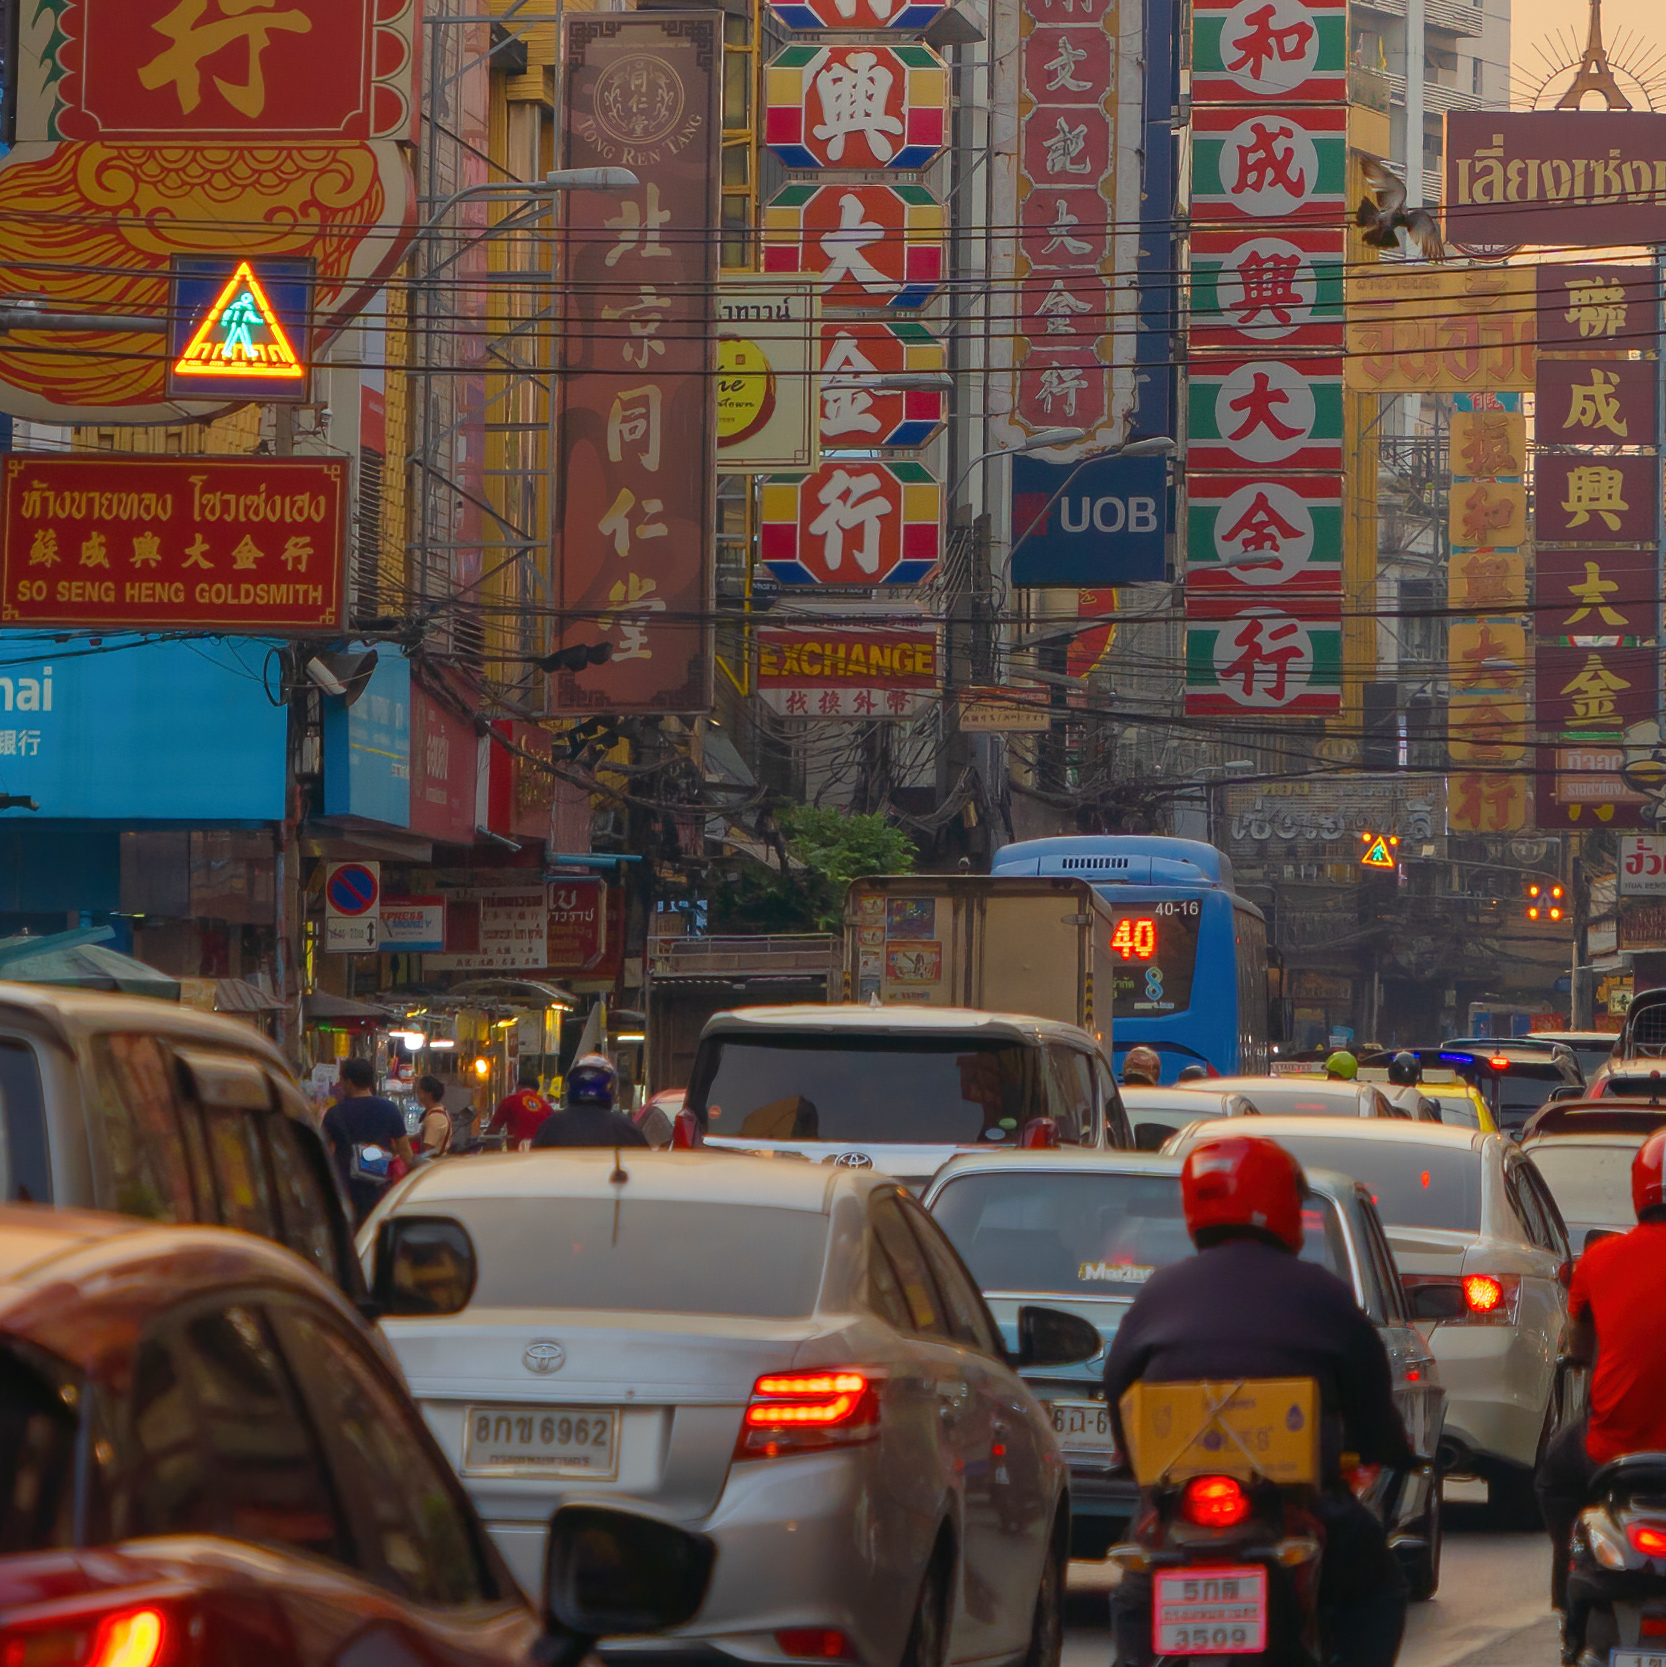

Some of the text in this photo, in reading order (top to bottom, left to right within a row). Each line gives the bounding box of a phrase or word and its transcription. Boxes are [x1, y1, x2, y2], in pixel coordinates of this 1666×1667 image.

[577, 113, 703, 166] TONG REN TANG
[21, 479, 172, 522] ห้างขายทอง
[1060, 495, 1158, 534] UOB
[1560, 276, 1632, 822] 聯成興大金
[17, 578, 324, 606] SO SENG HENG GOLDSMITH
[759, 641, 934, 677] EXCHANGE
[1155, 900, 1200, 917] 40-16
[1110, 917, 1157, 961] 40
[539, 1416, 608, 1447] 6962
[1174, 1628, 1247, 1650] 3509
